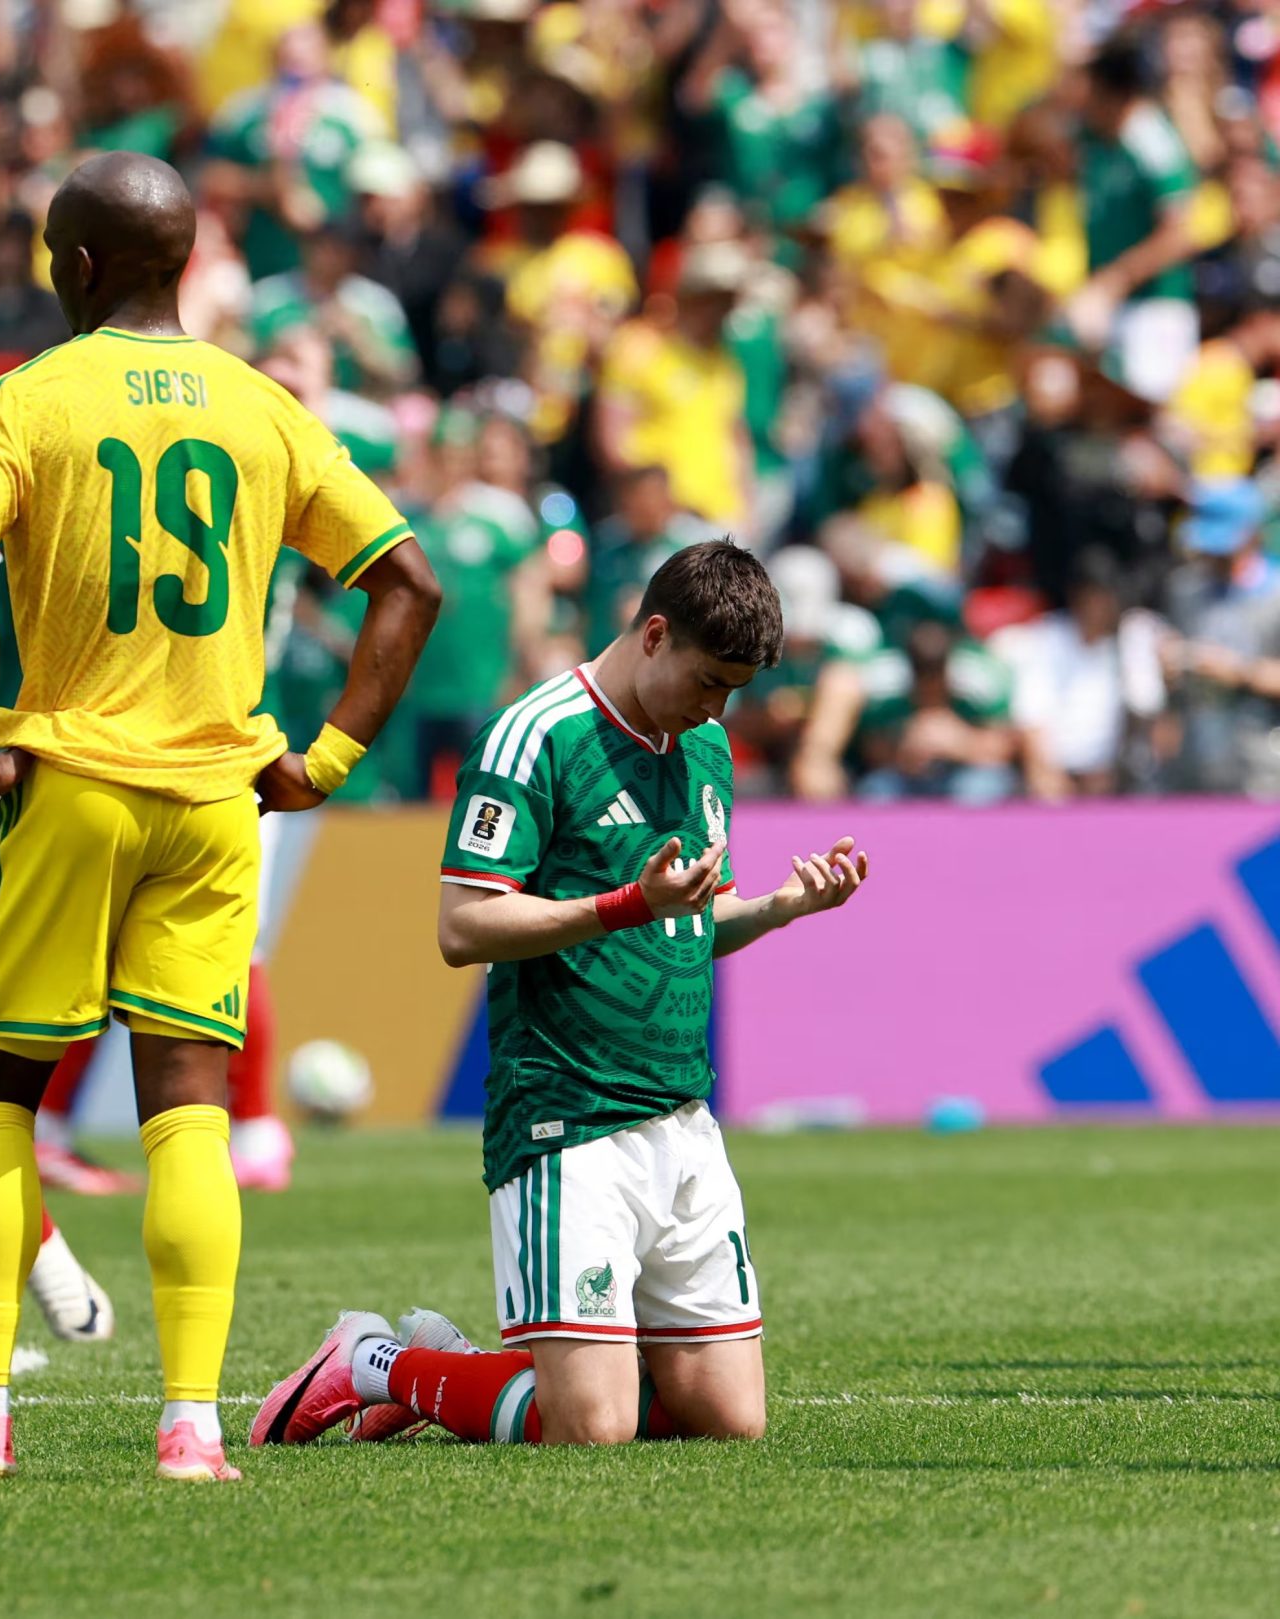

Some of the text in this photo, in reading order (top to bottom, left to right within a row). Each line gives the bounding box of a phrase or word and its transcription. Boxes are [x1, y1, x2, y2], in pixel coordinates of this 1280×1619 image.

[125, 369, 208, 408] SIBISI
[97, 437, 239, 637] 19
[467, 841, 490, 851] 2026
[728, 1225, 752, 1305] 1
